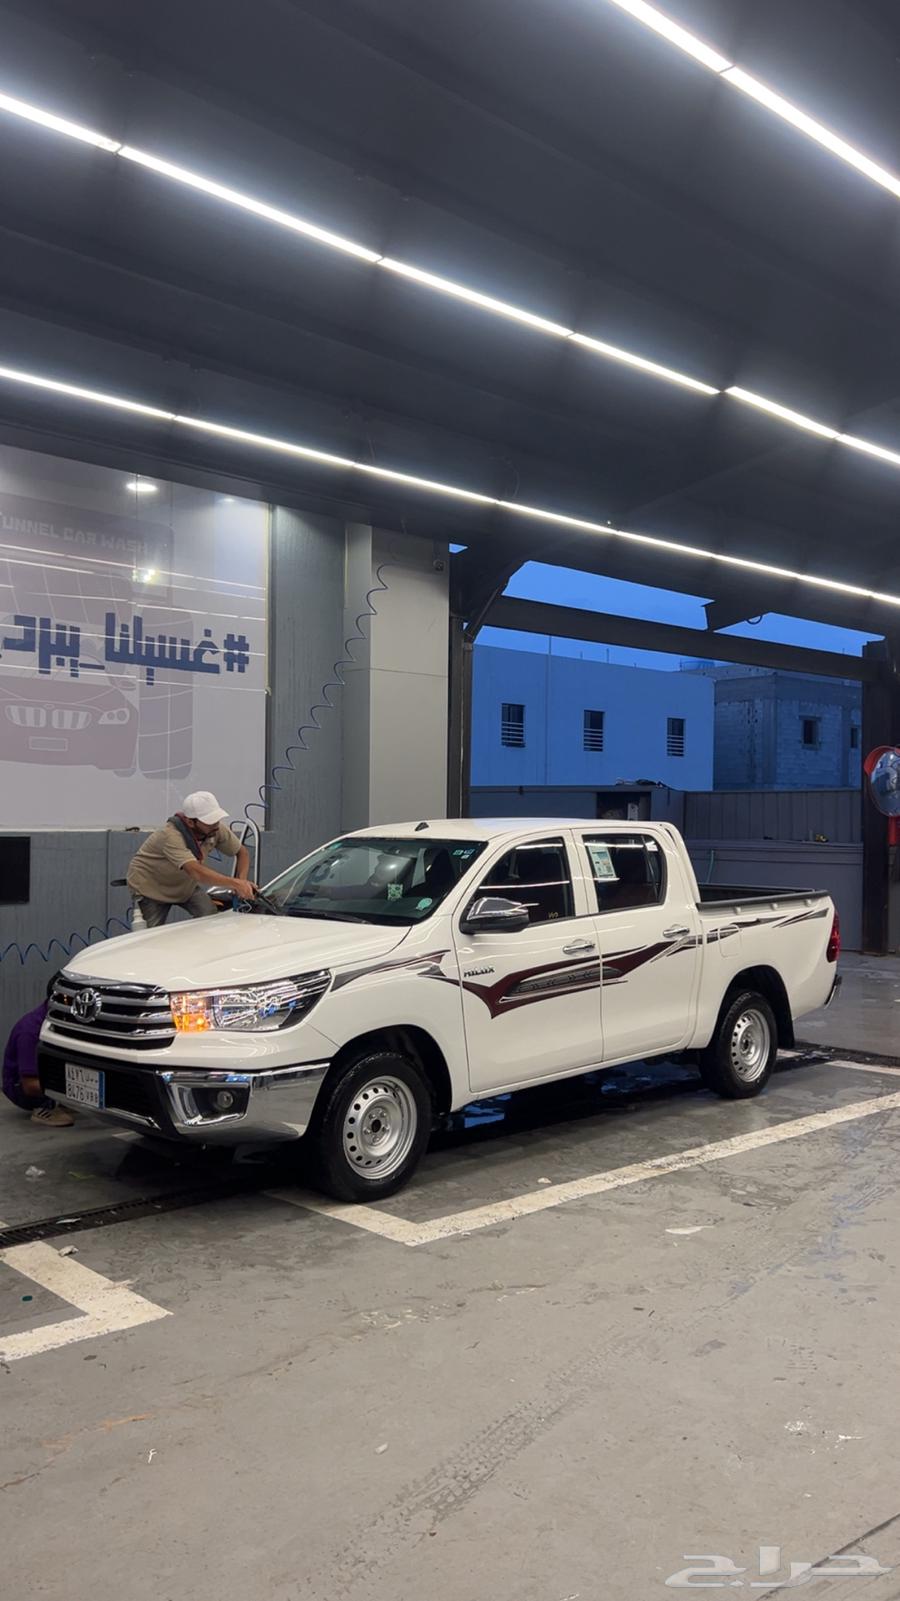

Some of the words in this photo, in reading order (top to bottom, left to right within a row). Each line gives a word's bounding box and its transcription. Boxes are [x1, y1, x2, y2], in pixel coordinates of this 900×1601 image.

[0, 511, 59, 539] UNNEL
[63, 527, 97, 545] CAR
[100, 534, 148, 553] WASH
[463, 966, 495, 978] HILUX
